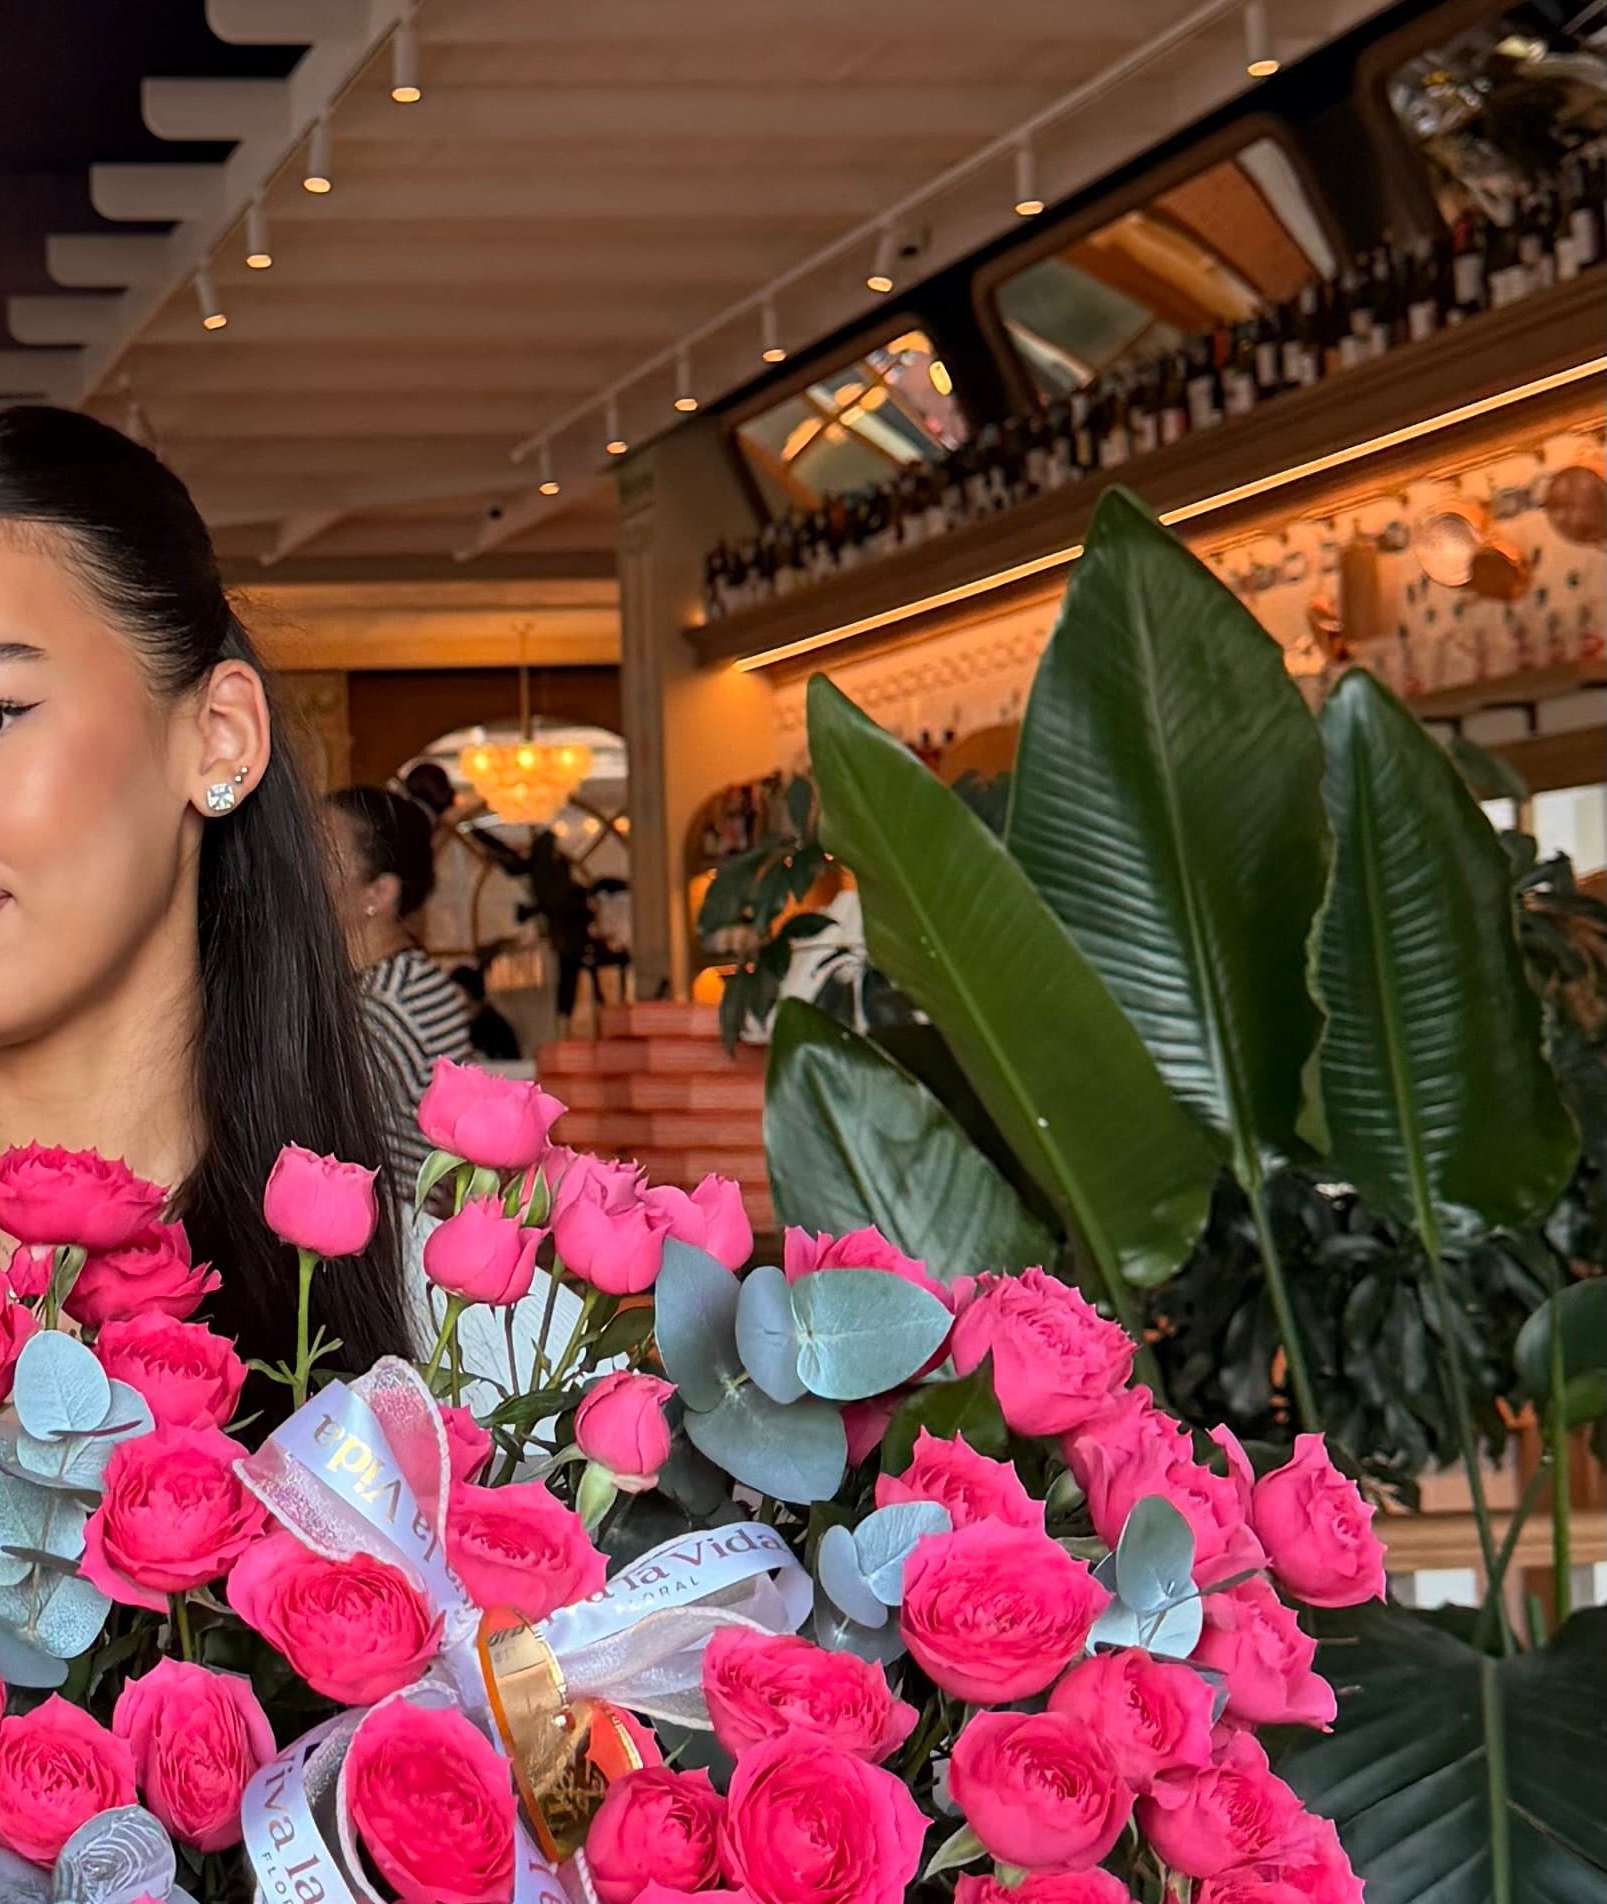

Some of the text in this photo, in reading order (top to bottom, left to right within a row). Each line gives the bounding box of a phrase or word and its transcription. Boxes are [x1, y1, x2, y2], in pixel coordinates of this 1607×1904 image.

[313, 1414, 401, 1525] Vida
[669, 1528, 788, 1567] Vida
[264, 1757, 295, 1853] iva
